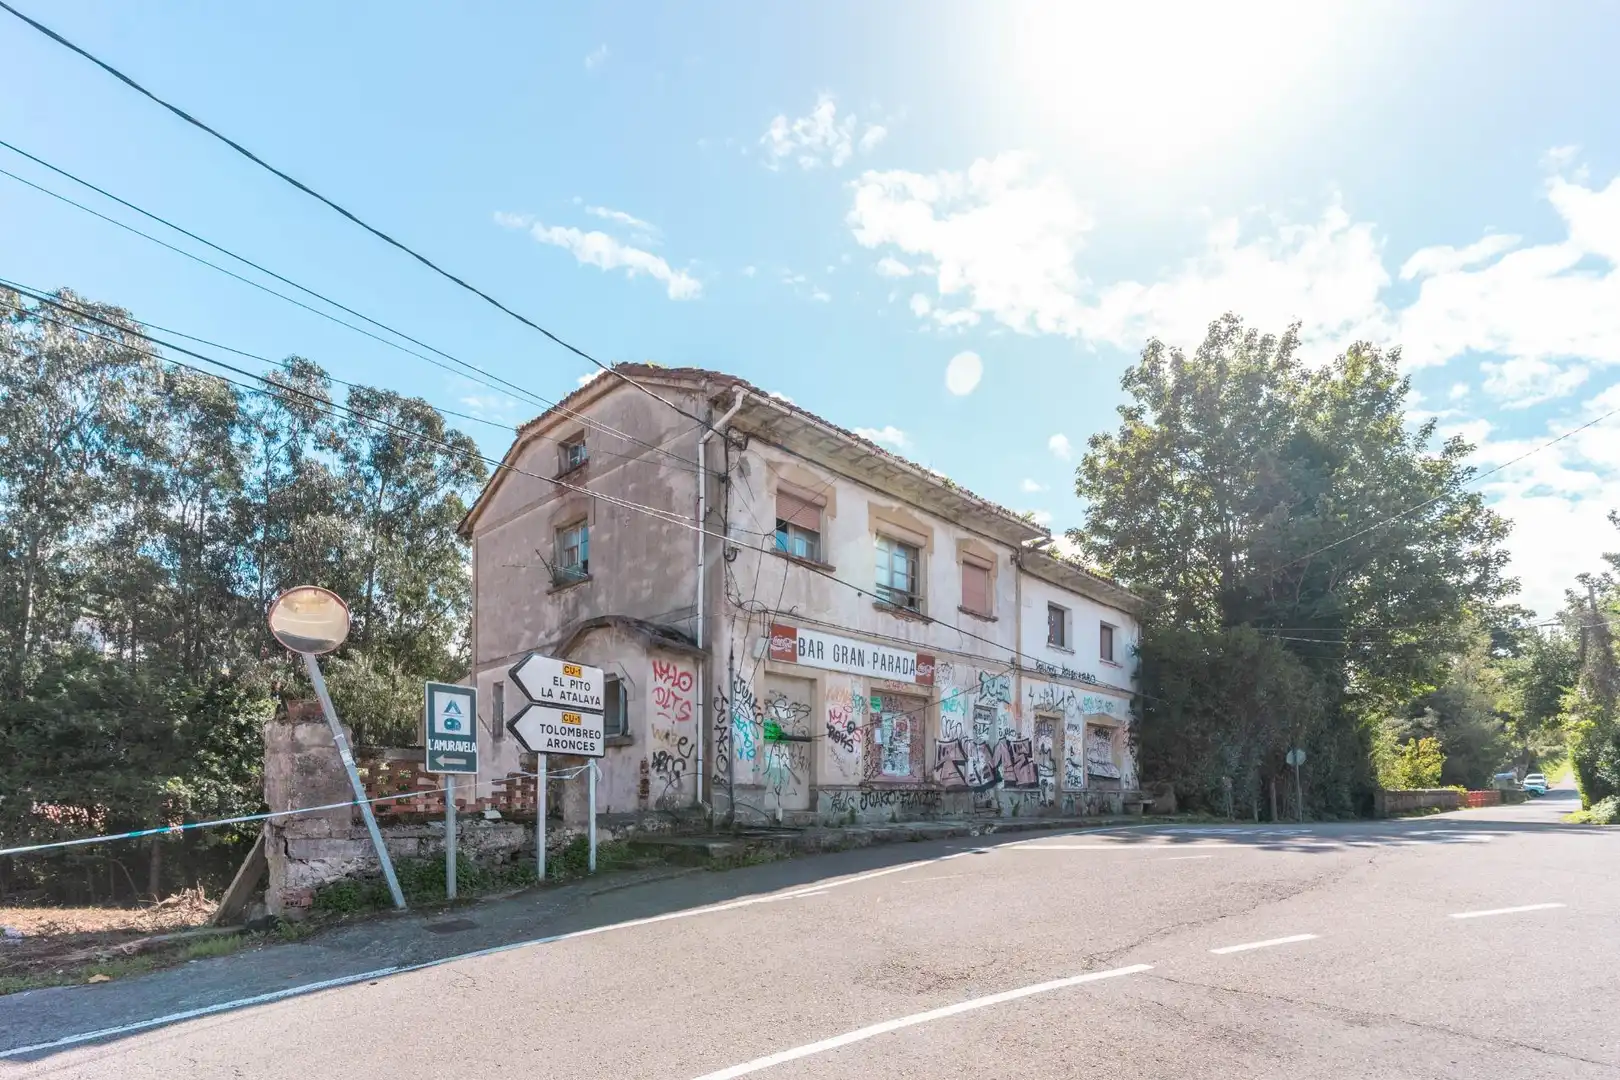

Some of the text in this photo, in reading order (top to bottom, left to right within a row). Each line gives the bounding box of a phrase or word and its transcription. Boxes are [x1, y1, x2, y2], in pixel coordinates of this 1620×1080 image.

[798, 637, 824, 660] BAR
[833, 644, 865, 667] GRAN
[872, 652, 916, 676] PARADA
[563, 665, 581, 676] CU-1
[553, 676, 591, 691] EL PITO
[541, 687, 601, 706] LA ATALAYA
[562, 714, 580, 723] CU-1
[539, 723, 602, 740] TOLOMBREO
[546, 738, 596, 752] ARONCES
